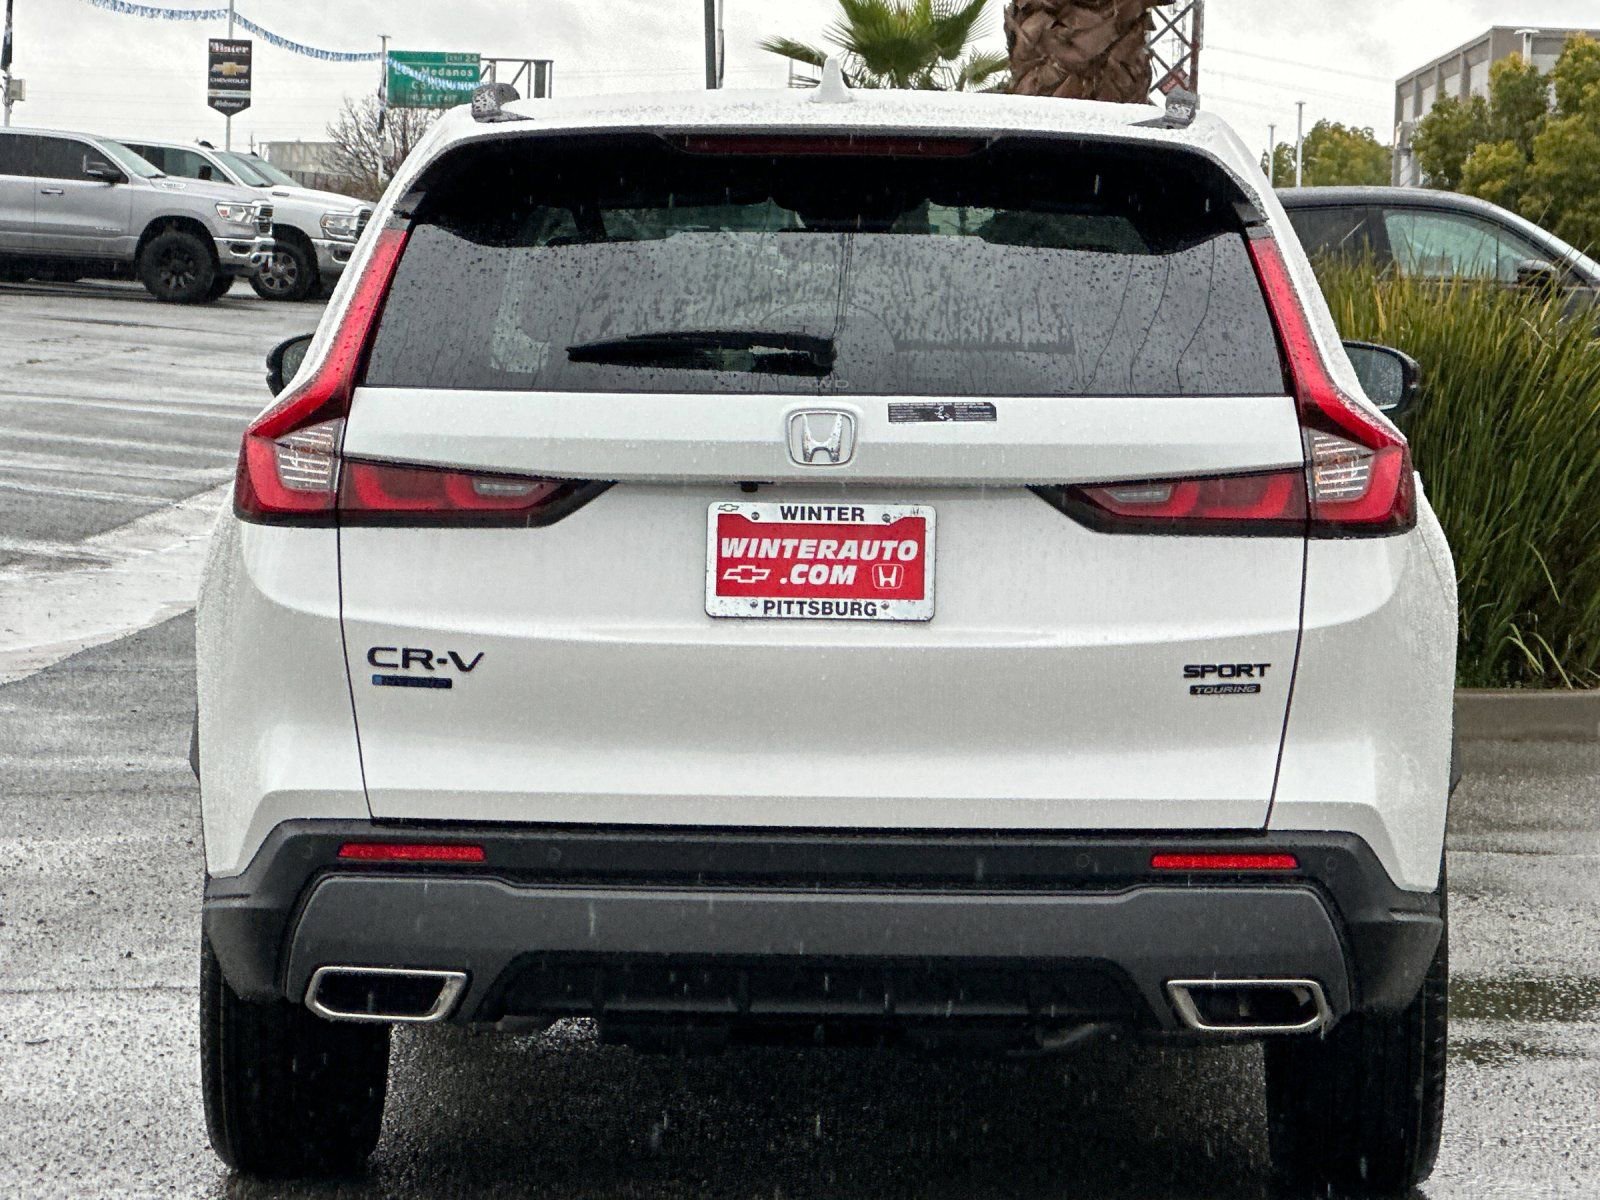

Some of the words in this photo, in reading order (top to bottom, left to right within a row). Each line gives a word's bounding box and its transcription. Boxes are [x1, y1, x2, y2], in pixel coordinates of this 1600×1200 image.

[421, 66, 473, 77] Medanos
[780, 505, 865, 522] WINTER
[721, 538, 918, 561] WINTERAUTO
[779, 564, 857, 585] .COM
[763, 600, 877, 616] PITTSBURG
[367, 646, 484, 672] CR-V
[1183, 663, 1271, 678] SPORT
[1195, 686, 1256, 694] TOURING
